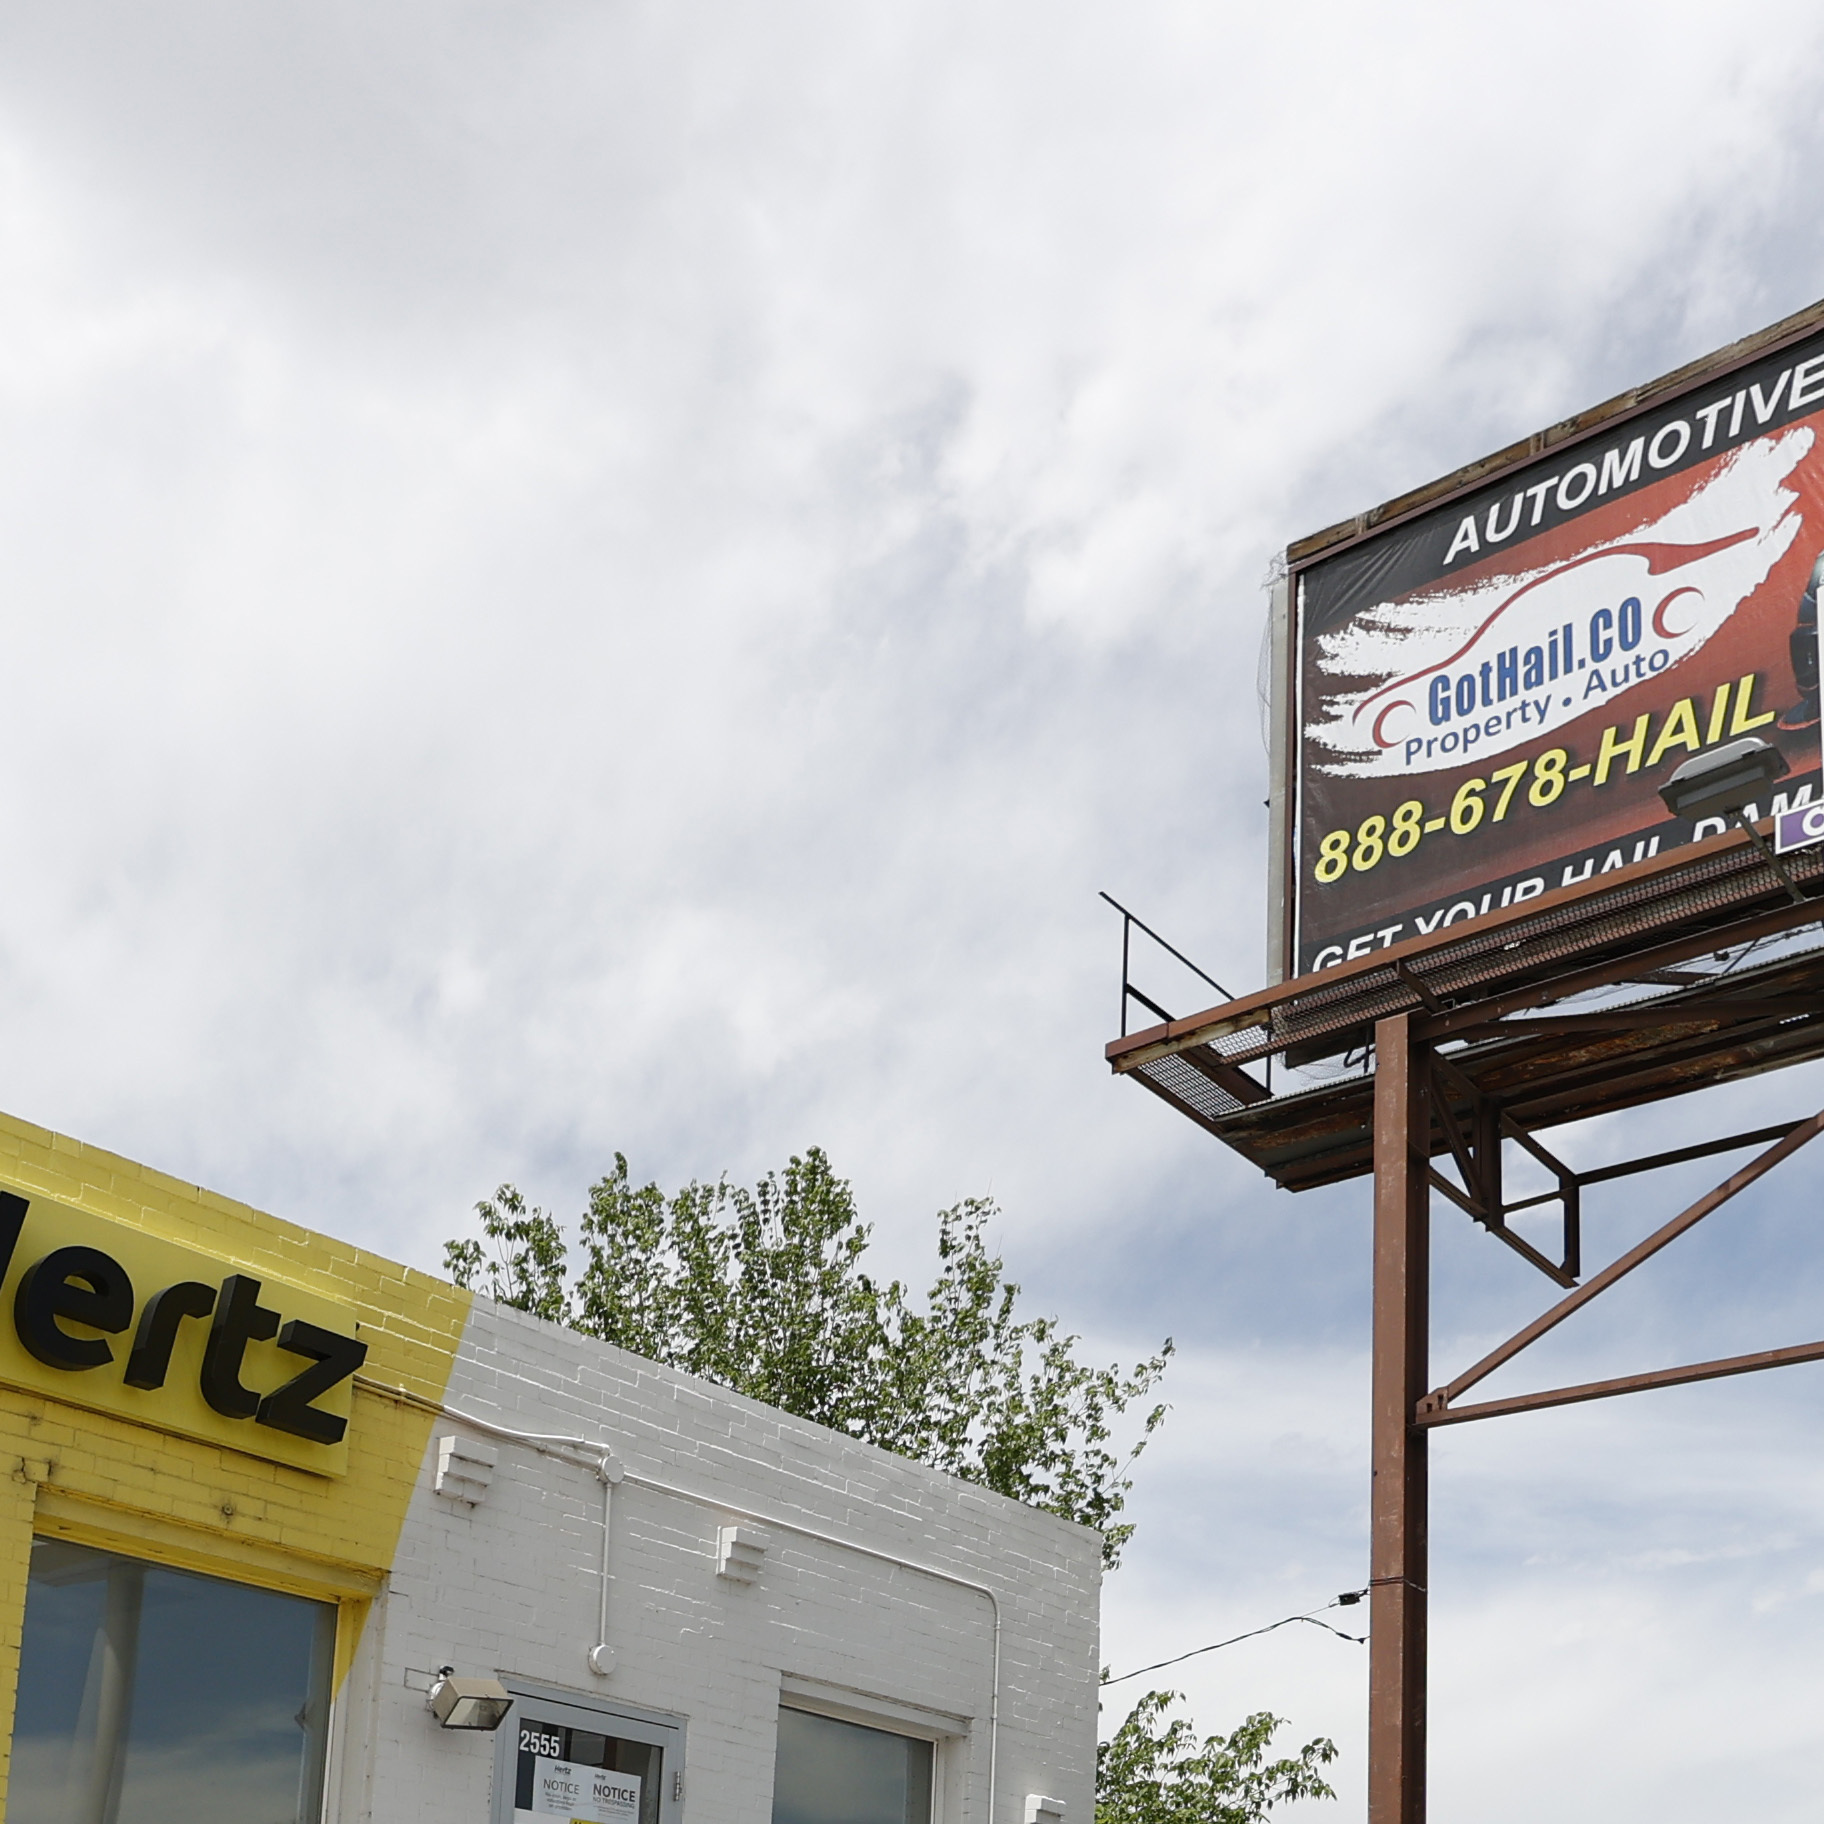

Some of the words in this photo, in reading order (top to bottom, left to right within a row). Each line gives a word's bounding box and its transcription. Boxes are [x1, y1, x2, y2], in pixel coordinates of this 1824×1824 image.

[1428, 597, 1642, 727] GotHail.CO
[1404, 693, 1552, 766] Property
[1582, 648, 1670, 700] Auto
[1314, 673, 1776, 883] 888-678-HAIL
[519, 1730, 560, 1757] 2555
[554, 1765, 572, 1776] Hertz
[543, 1779, 580, 1795] NOTICE
[593, 1783, 636, 1802] NOTICE
